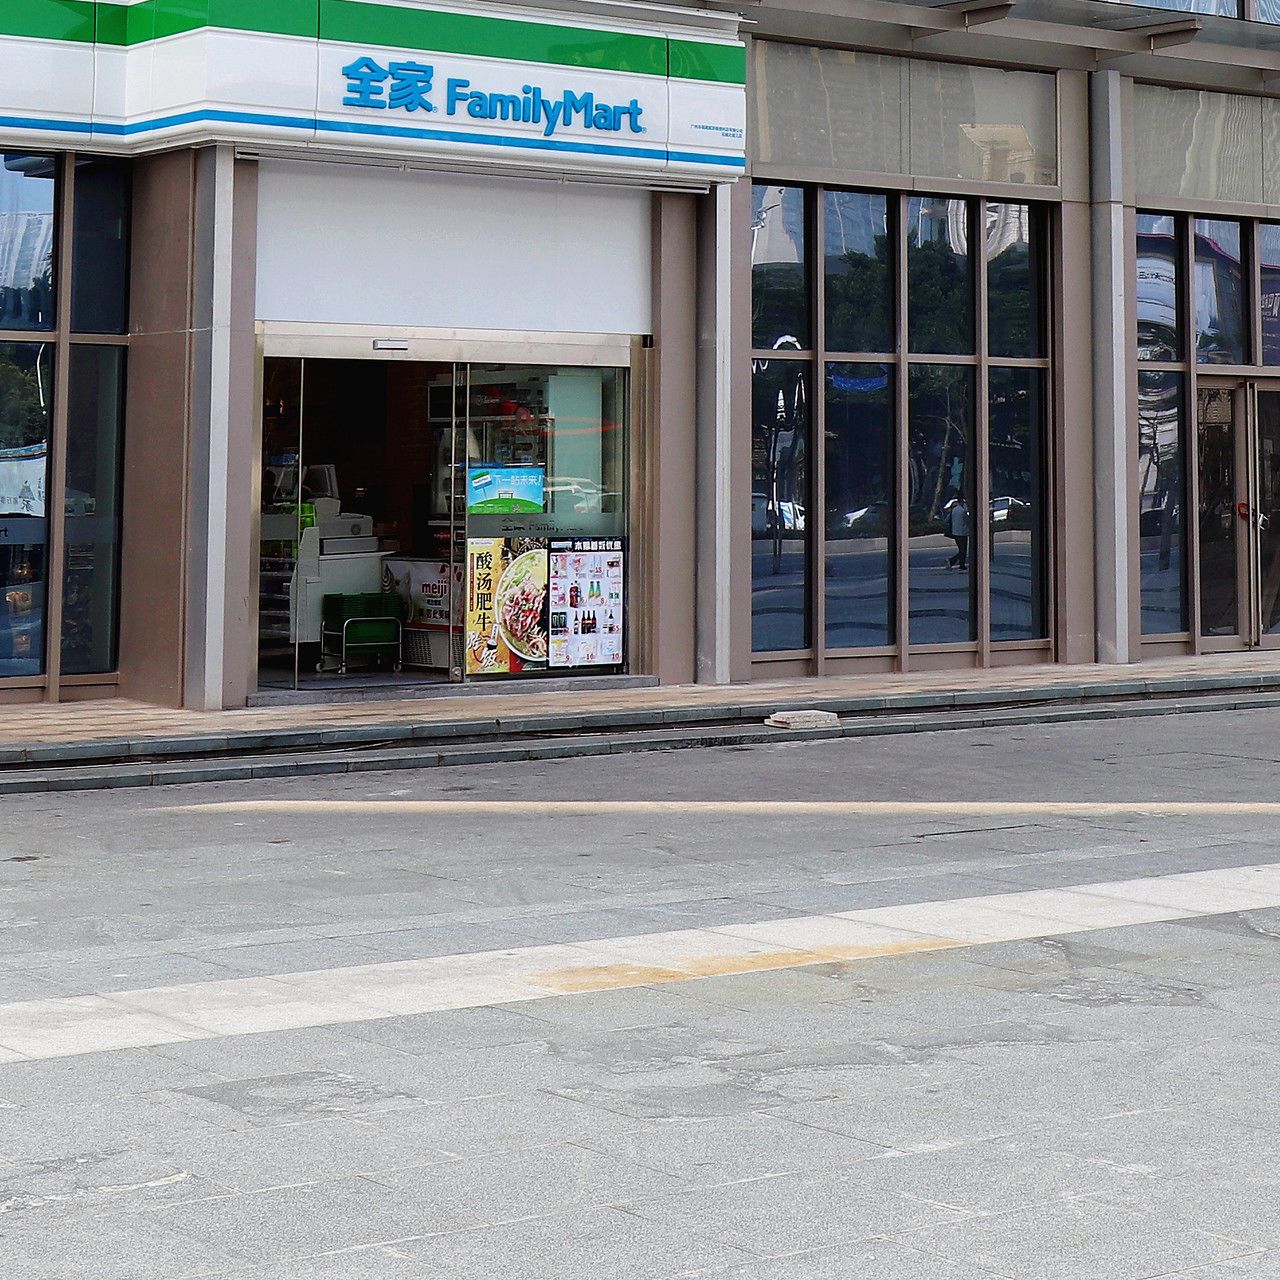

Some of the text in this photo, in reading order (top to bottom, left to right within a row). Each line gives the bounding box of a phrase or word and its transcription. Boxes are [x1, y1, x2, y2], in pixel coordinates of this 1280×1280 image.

[341, 56, 644, 136] 全家 FamilyMart
[422, 580, 447, 598] meiji
[475, 552, 493, 631] 酸汤肥牛
